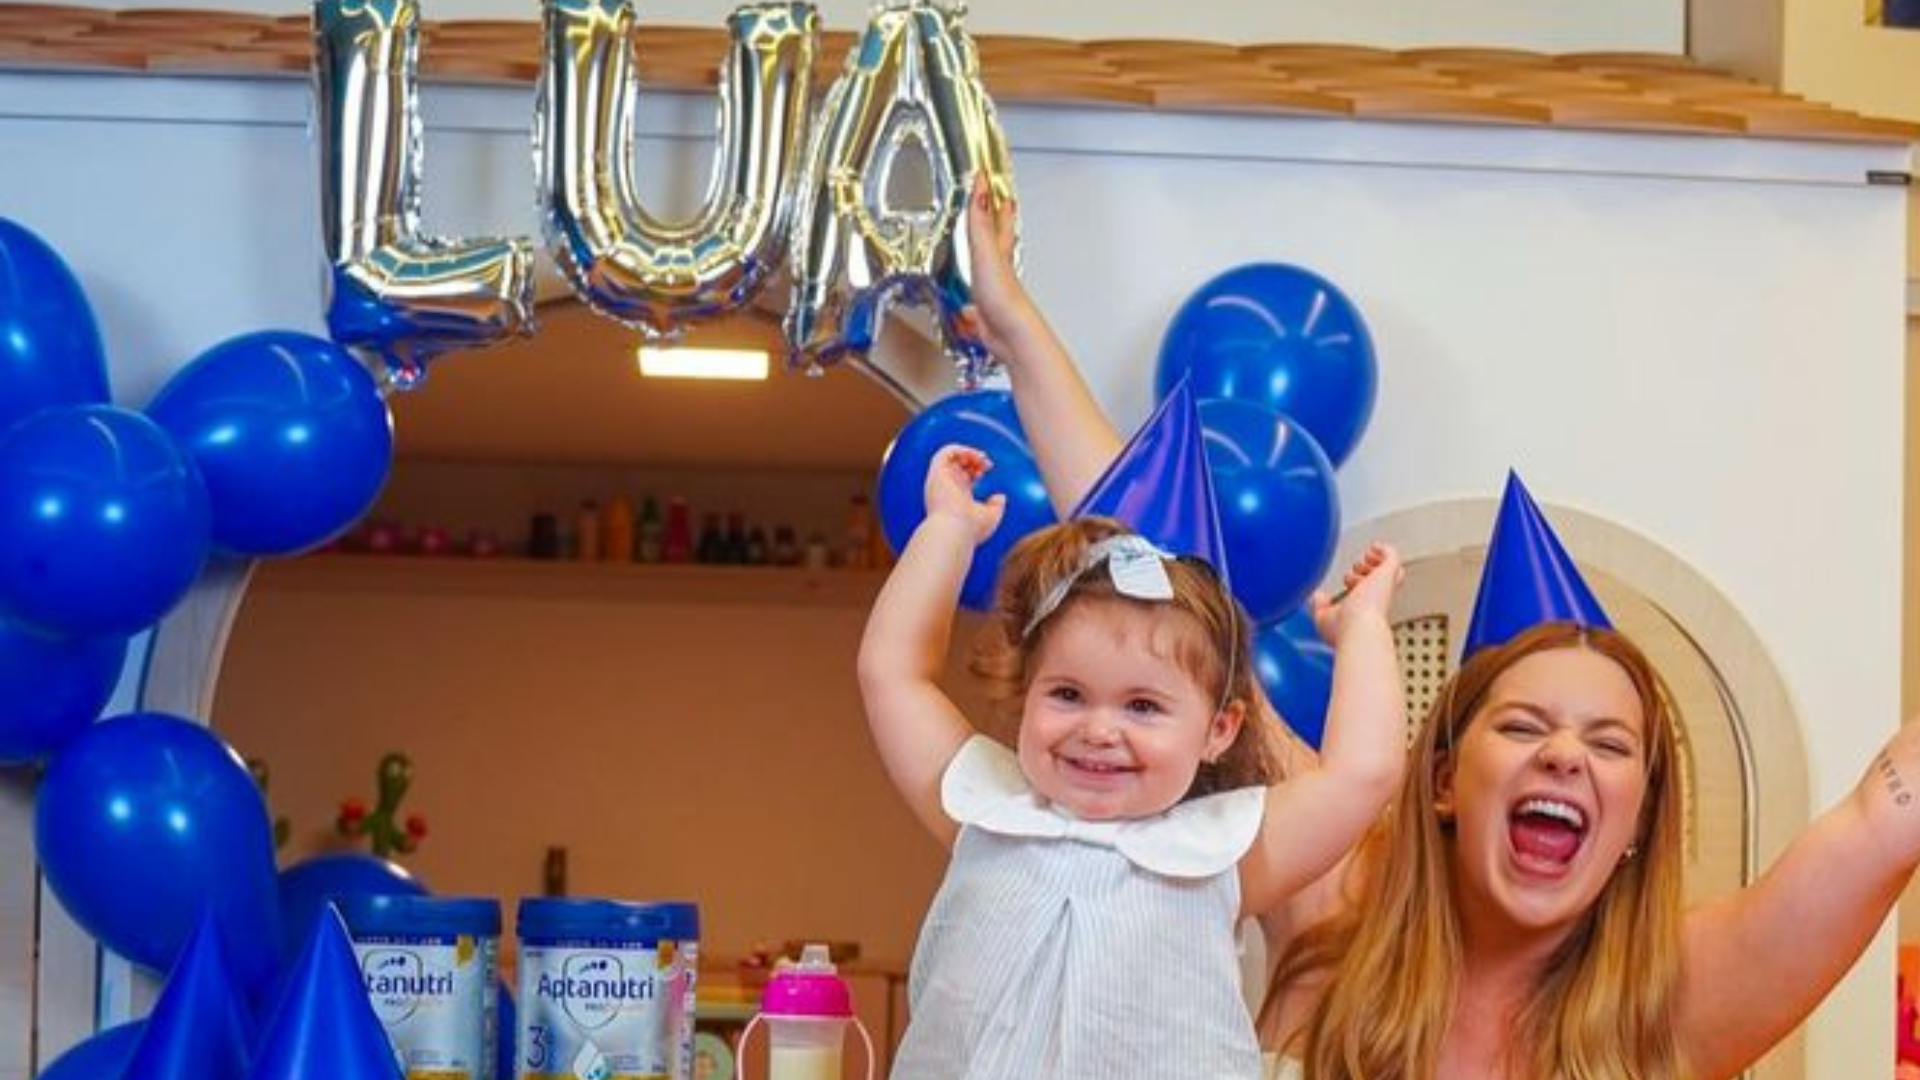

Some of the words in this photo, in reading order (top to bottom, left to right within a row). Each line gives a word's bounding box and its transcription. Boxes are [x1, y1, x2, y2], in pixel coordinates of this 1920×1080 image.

[314, 0, 1020, 380] LUA
[366, 972, 453, 995] tanutri
[537, 973, 654, 1002] Aptanutri
[526, 1025, 546, 1068] 3
